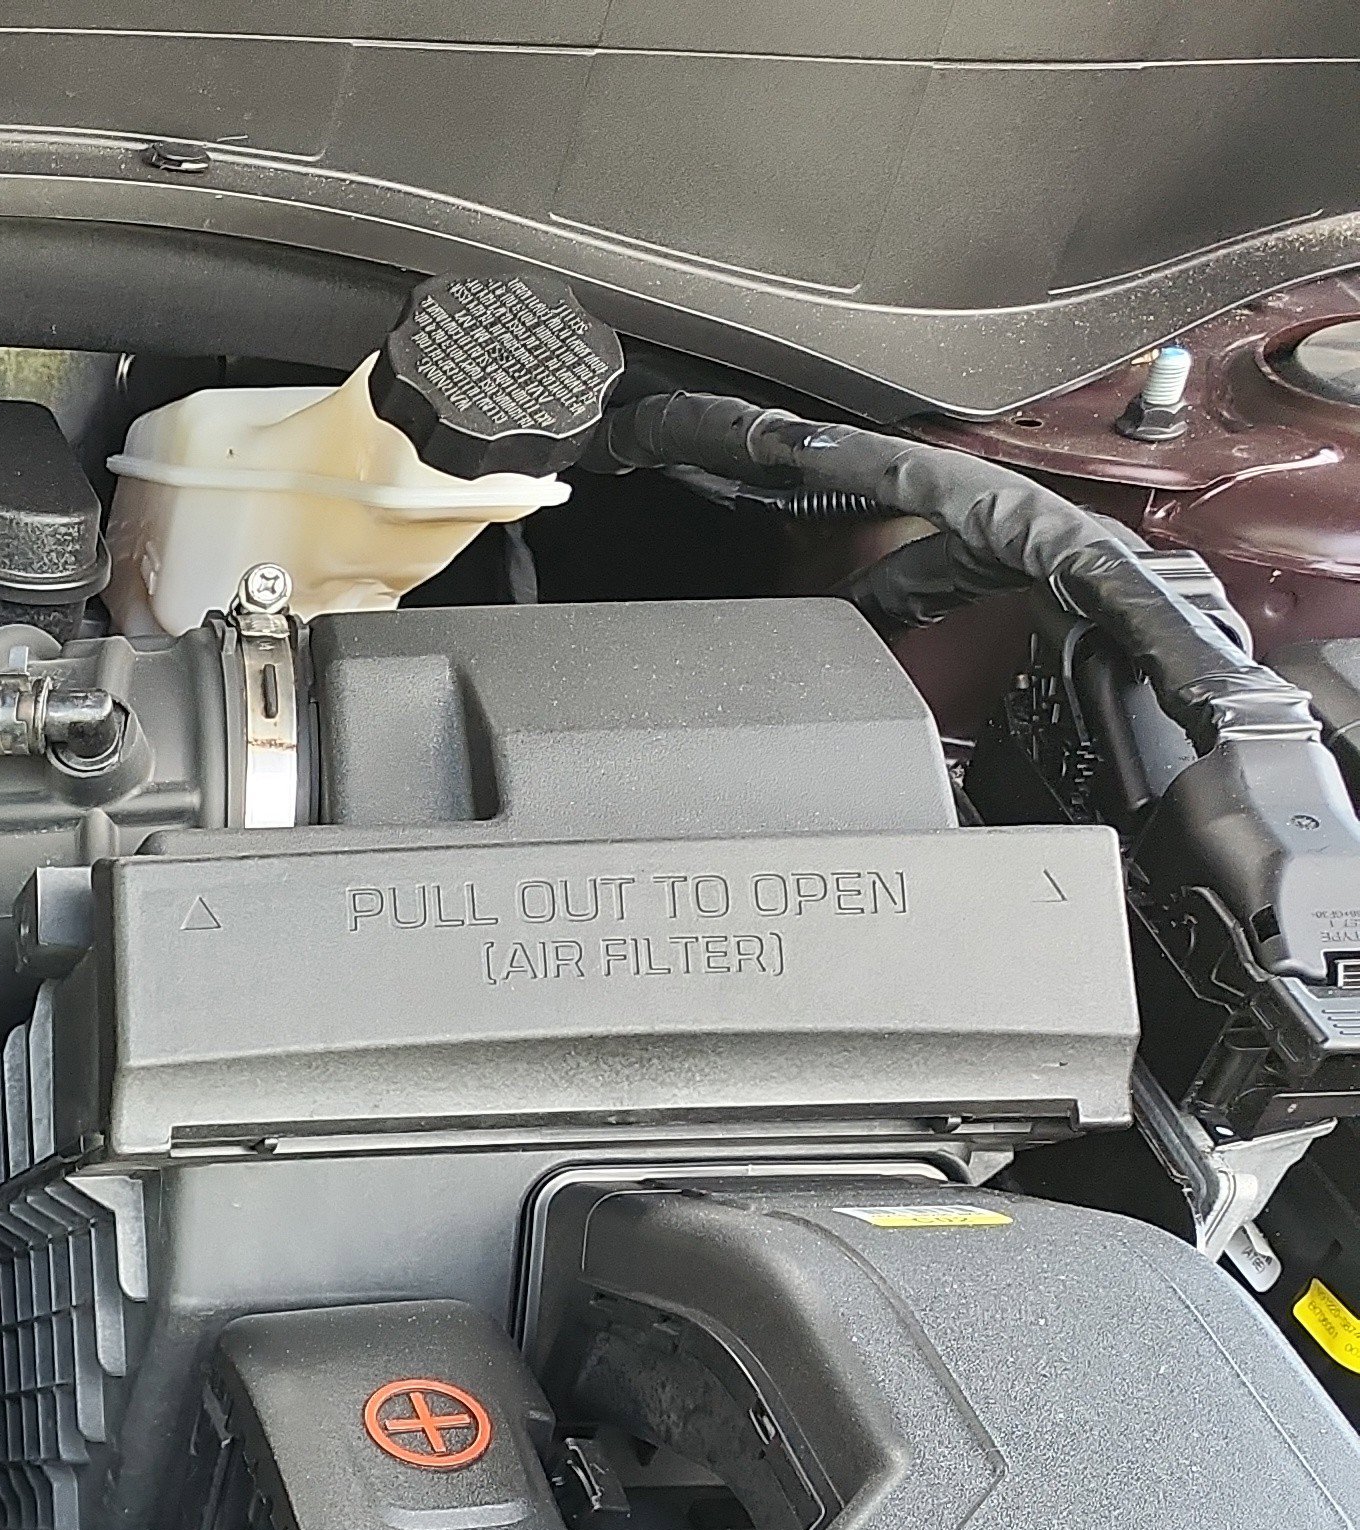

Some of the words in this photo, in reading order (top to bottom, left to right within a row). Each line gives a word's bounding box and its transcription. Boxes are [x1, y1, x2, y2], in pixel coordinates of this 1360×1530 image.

[346, 881, 499, 933] PULL
[517, 875, 636, 925] OUT
[653, 872, 731, 920] TO
[751, 870, 909, 917] OPEN
